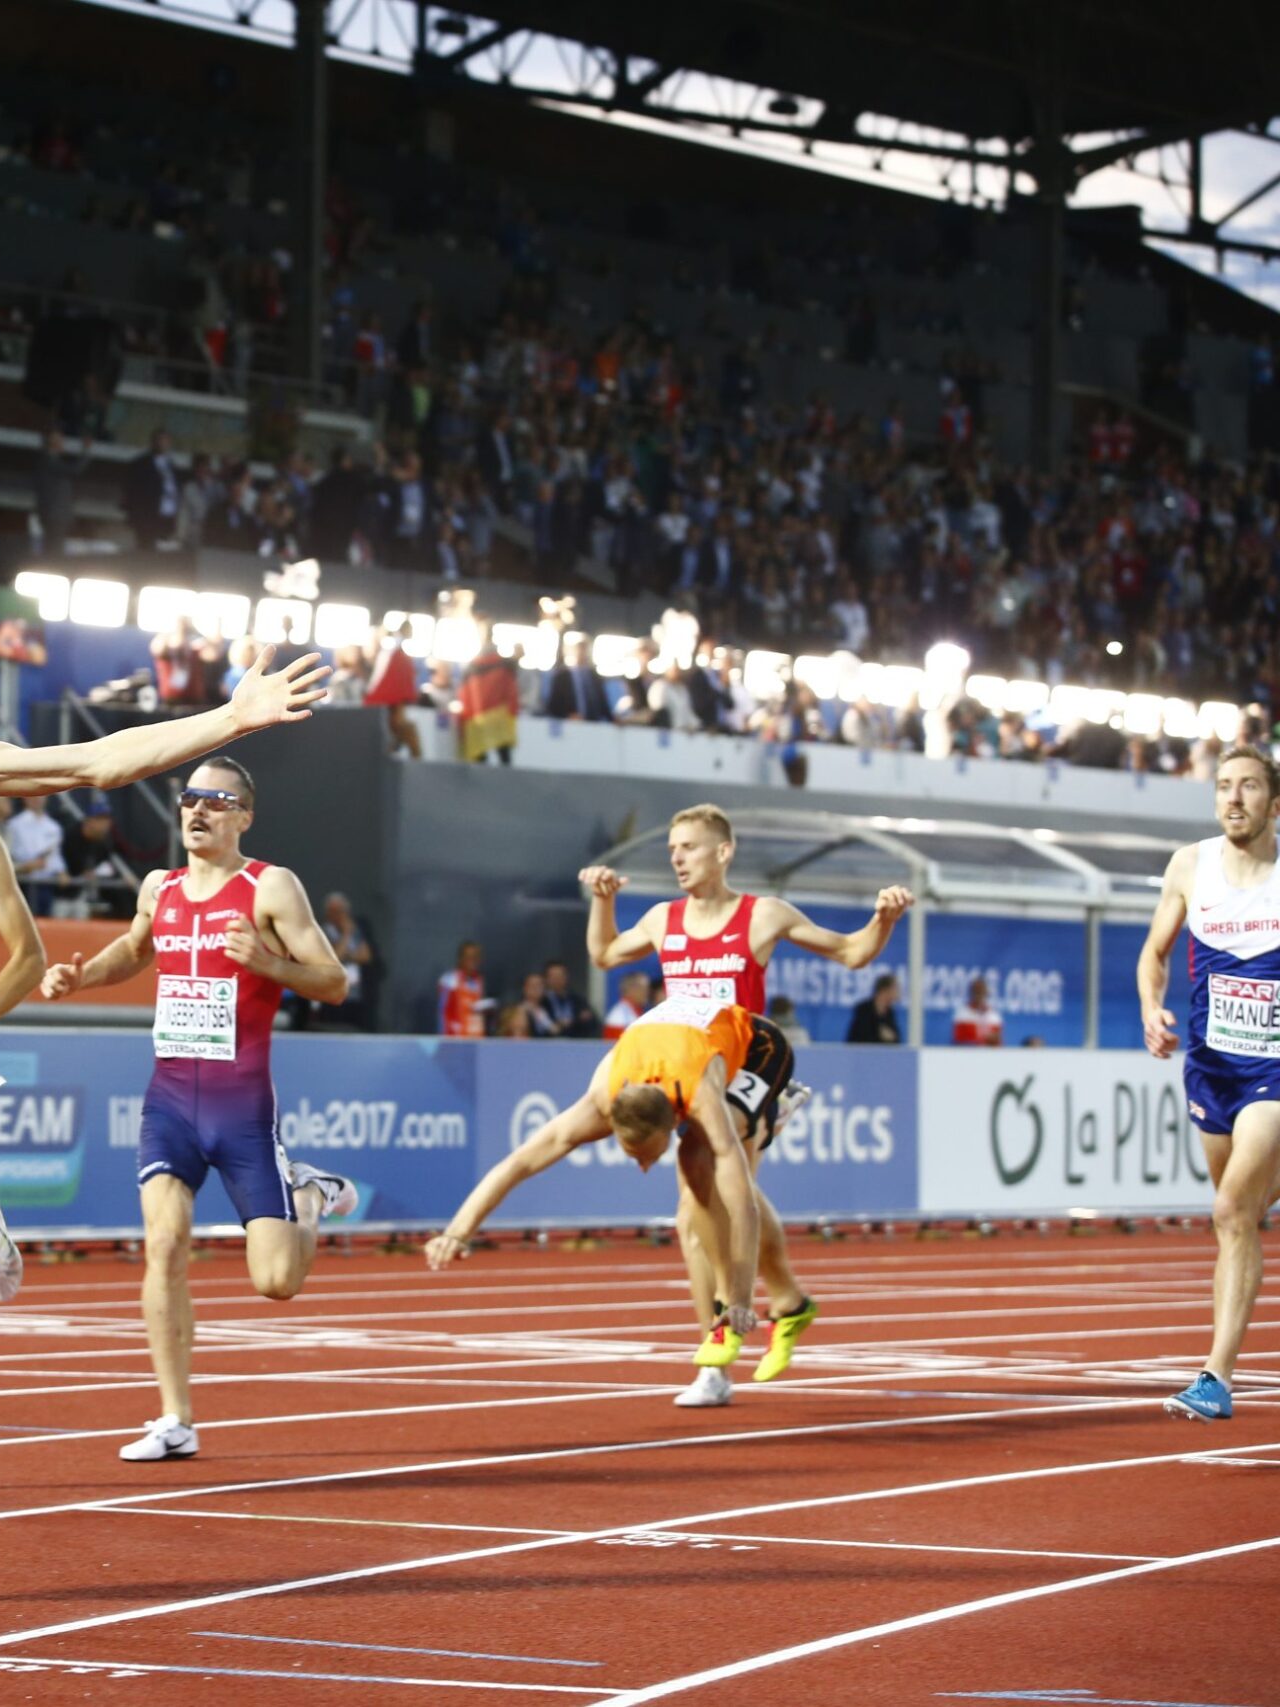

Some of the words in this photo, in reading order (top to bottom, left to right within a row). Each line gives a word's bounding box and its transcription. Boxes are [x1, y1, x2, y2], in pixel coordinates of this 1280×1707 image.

[1202, 921, 1240, 934] GREAT
[153, 931, 227, 953] NORWA
[160, 980, 209, 998] SPAR
[1210, 977, 1273, 1001] SPAR
[1214, 997, 1280, 1029] EMANUE
[738, 1073, 758, 1098] 2
